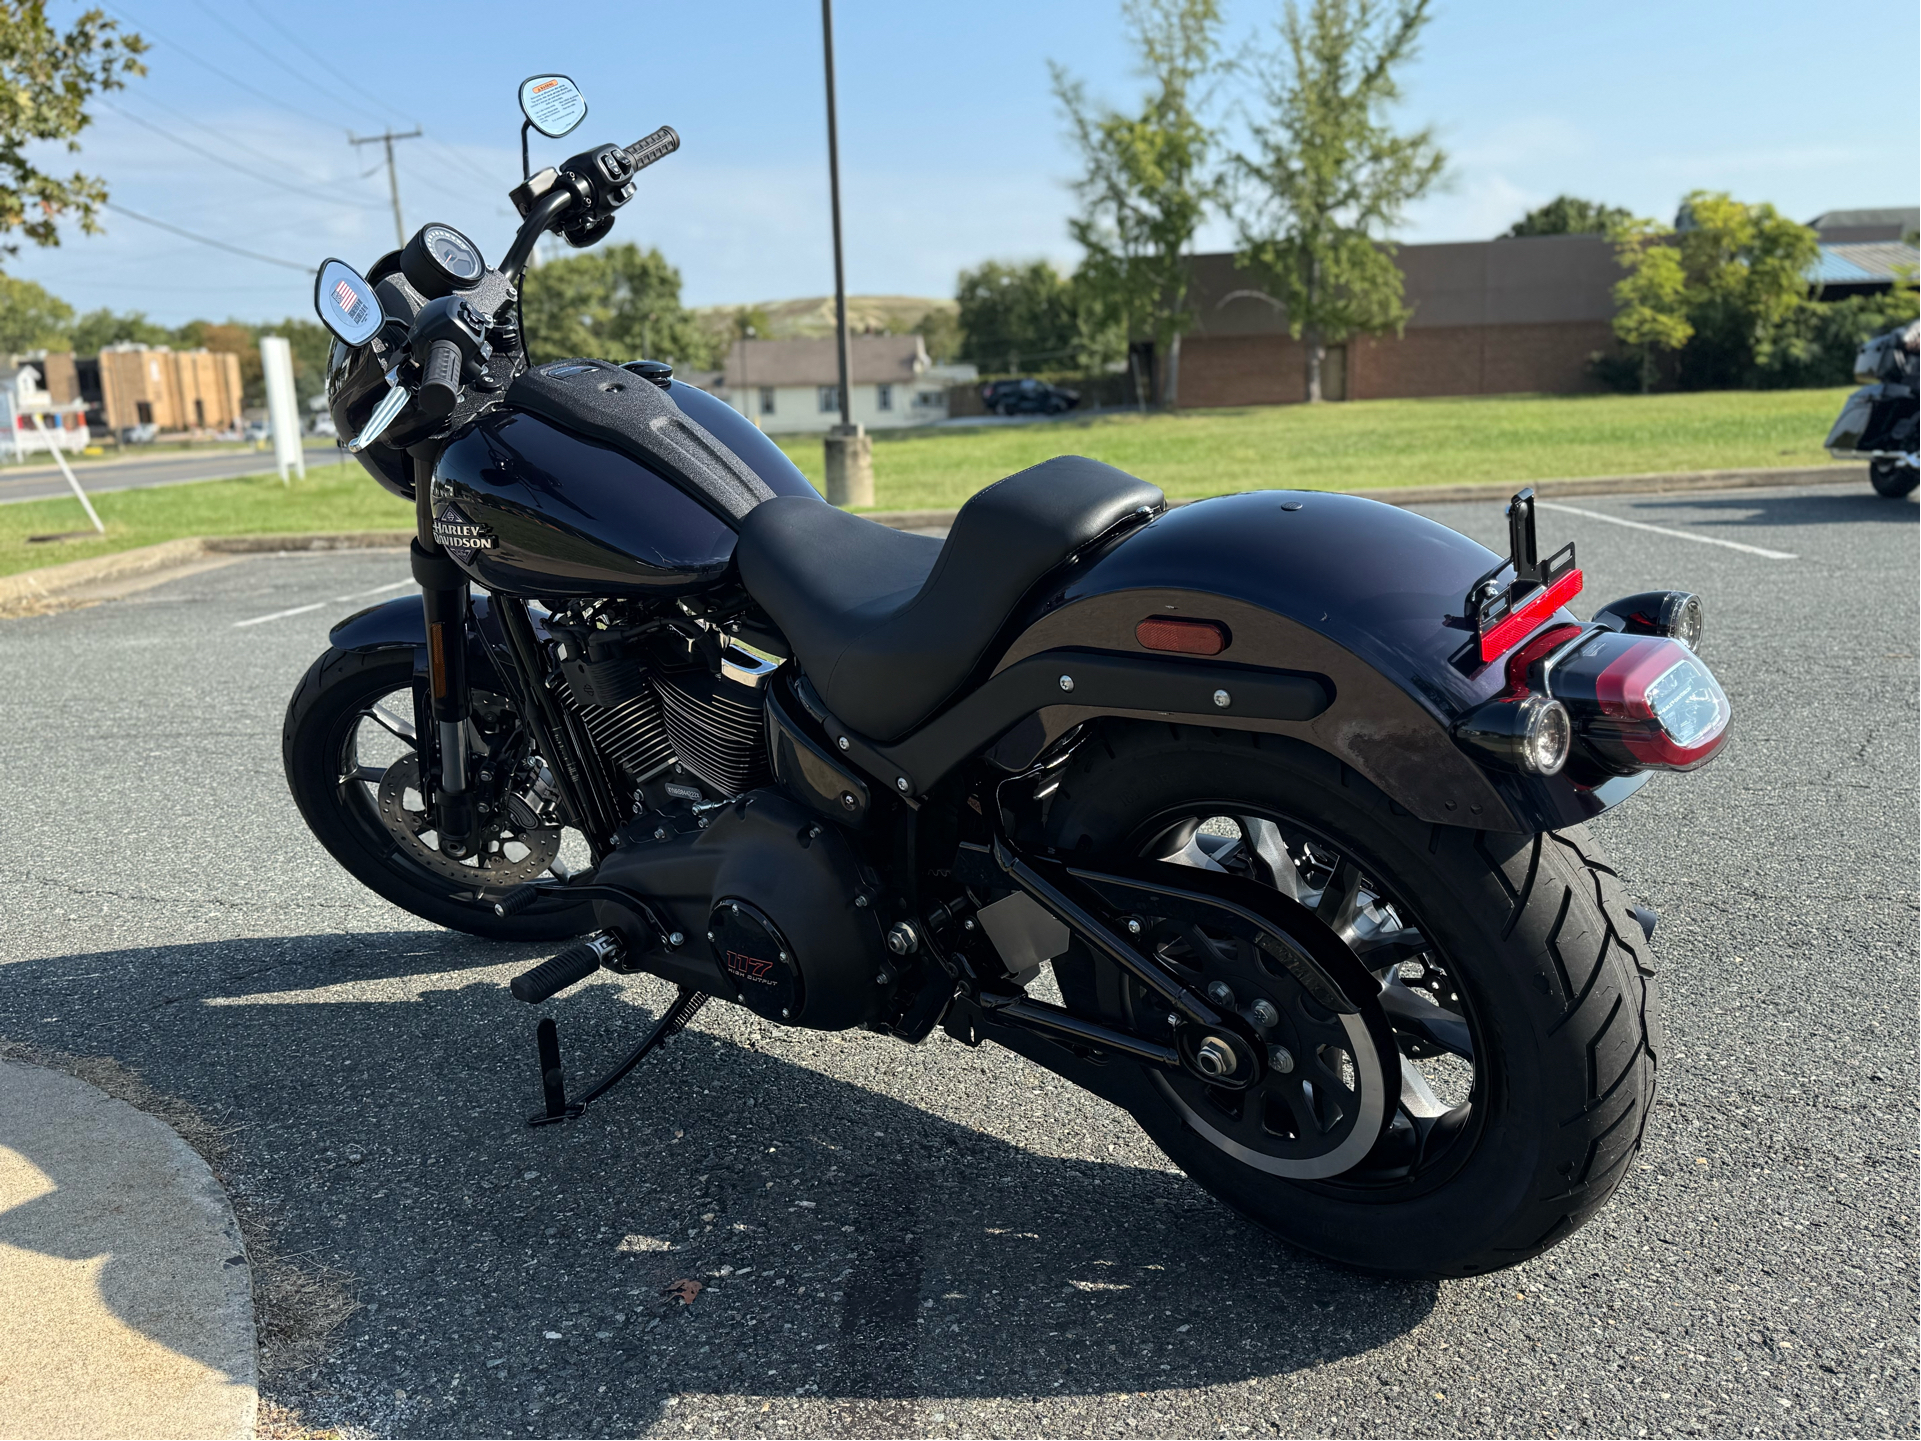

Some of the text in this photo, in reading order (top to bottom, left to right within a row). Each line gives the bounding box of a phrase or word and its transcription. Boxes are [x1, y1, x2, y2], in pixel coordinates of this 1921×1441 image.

[432, 521, 484, 536] HARLEY-
[433, 532, 491, 548] DAVIDSON
[726, 950, 774, 977] 117
[728, 967, 778, 986] HIGH OUTPUT
